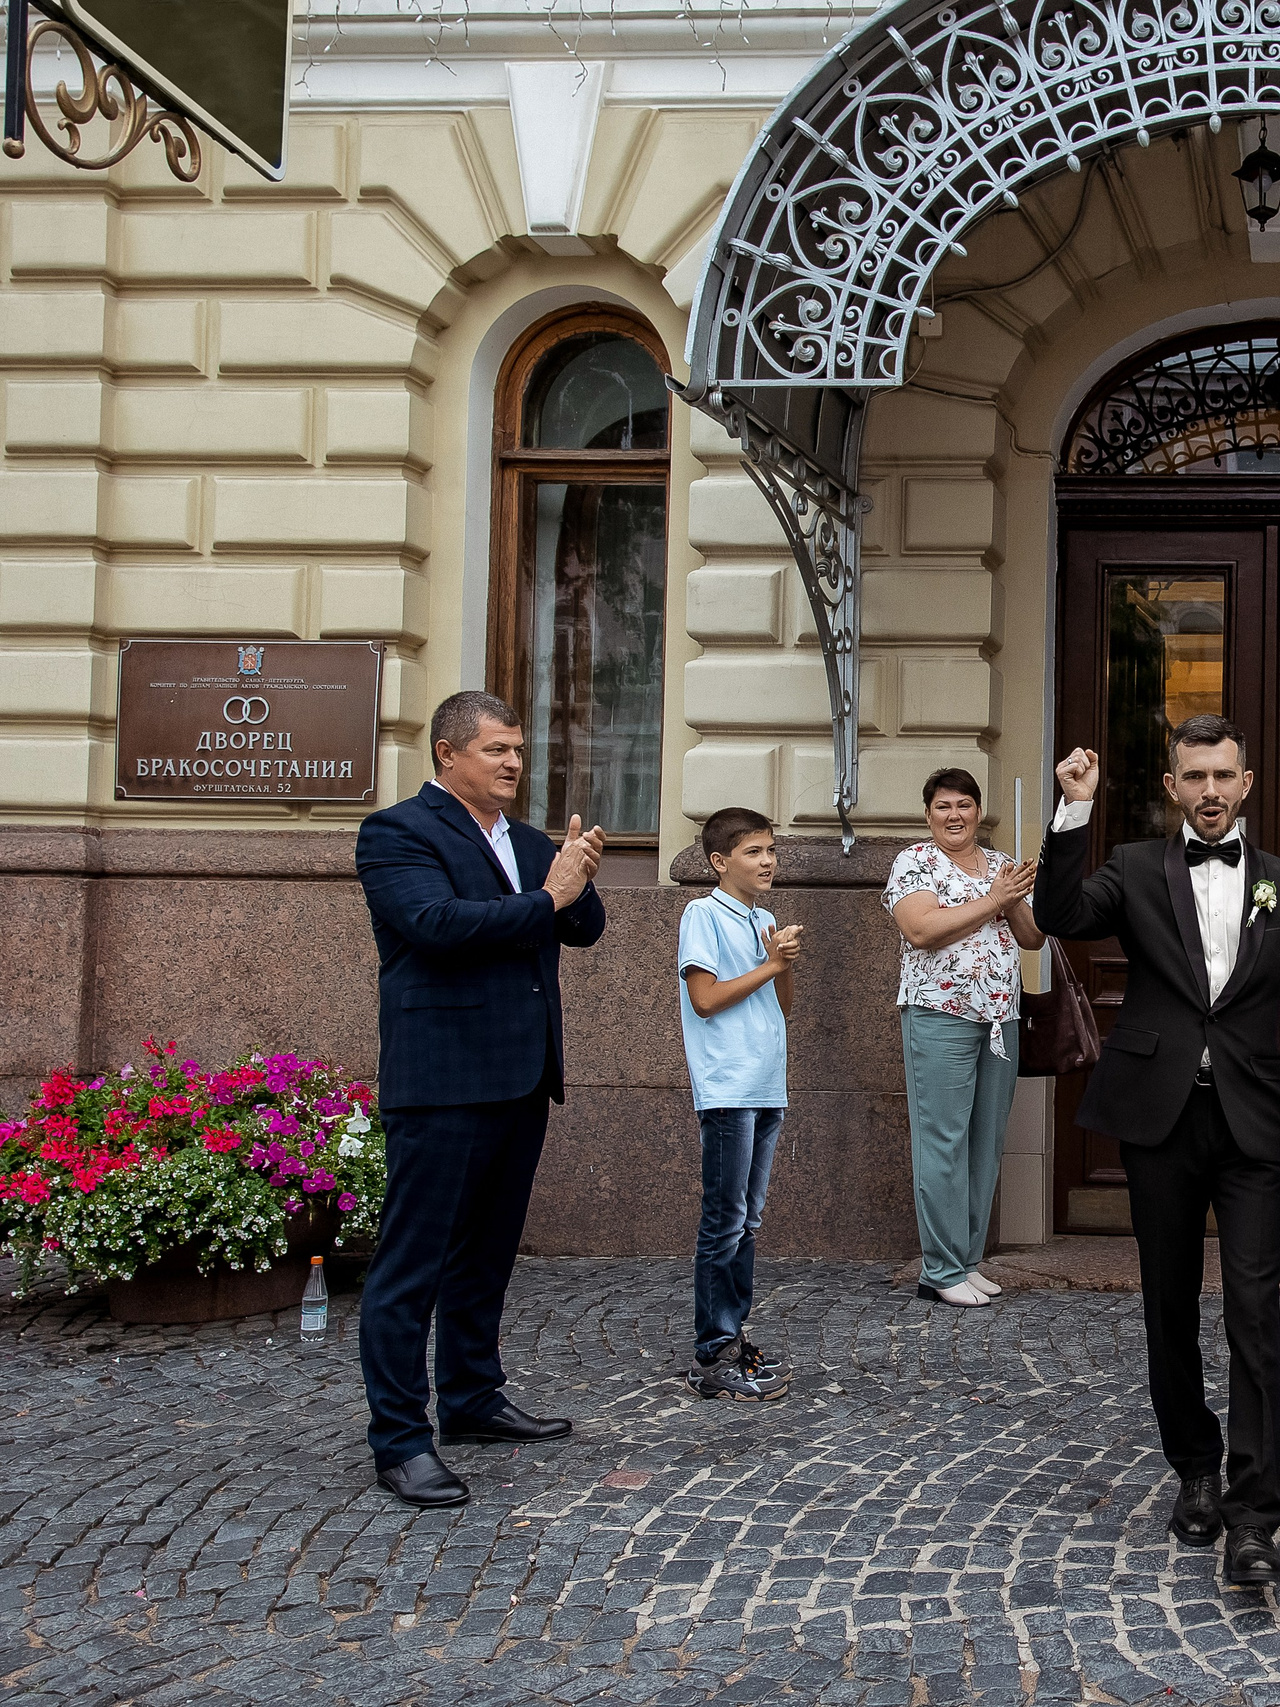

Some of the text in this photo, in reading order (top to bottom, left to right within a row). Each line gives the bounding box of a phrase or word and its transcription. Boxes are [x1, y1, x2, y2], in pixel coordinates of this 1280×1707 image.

[195, 731, 293, 753] ДВОРЕЦ
[136, 758, 353, 779] БРАКОСОЧЕТАНИЯ
[277, 783, 291, 793] 52
